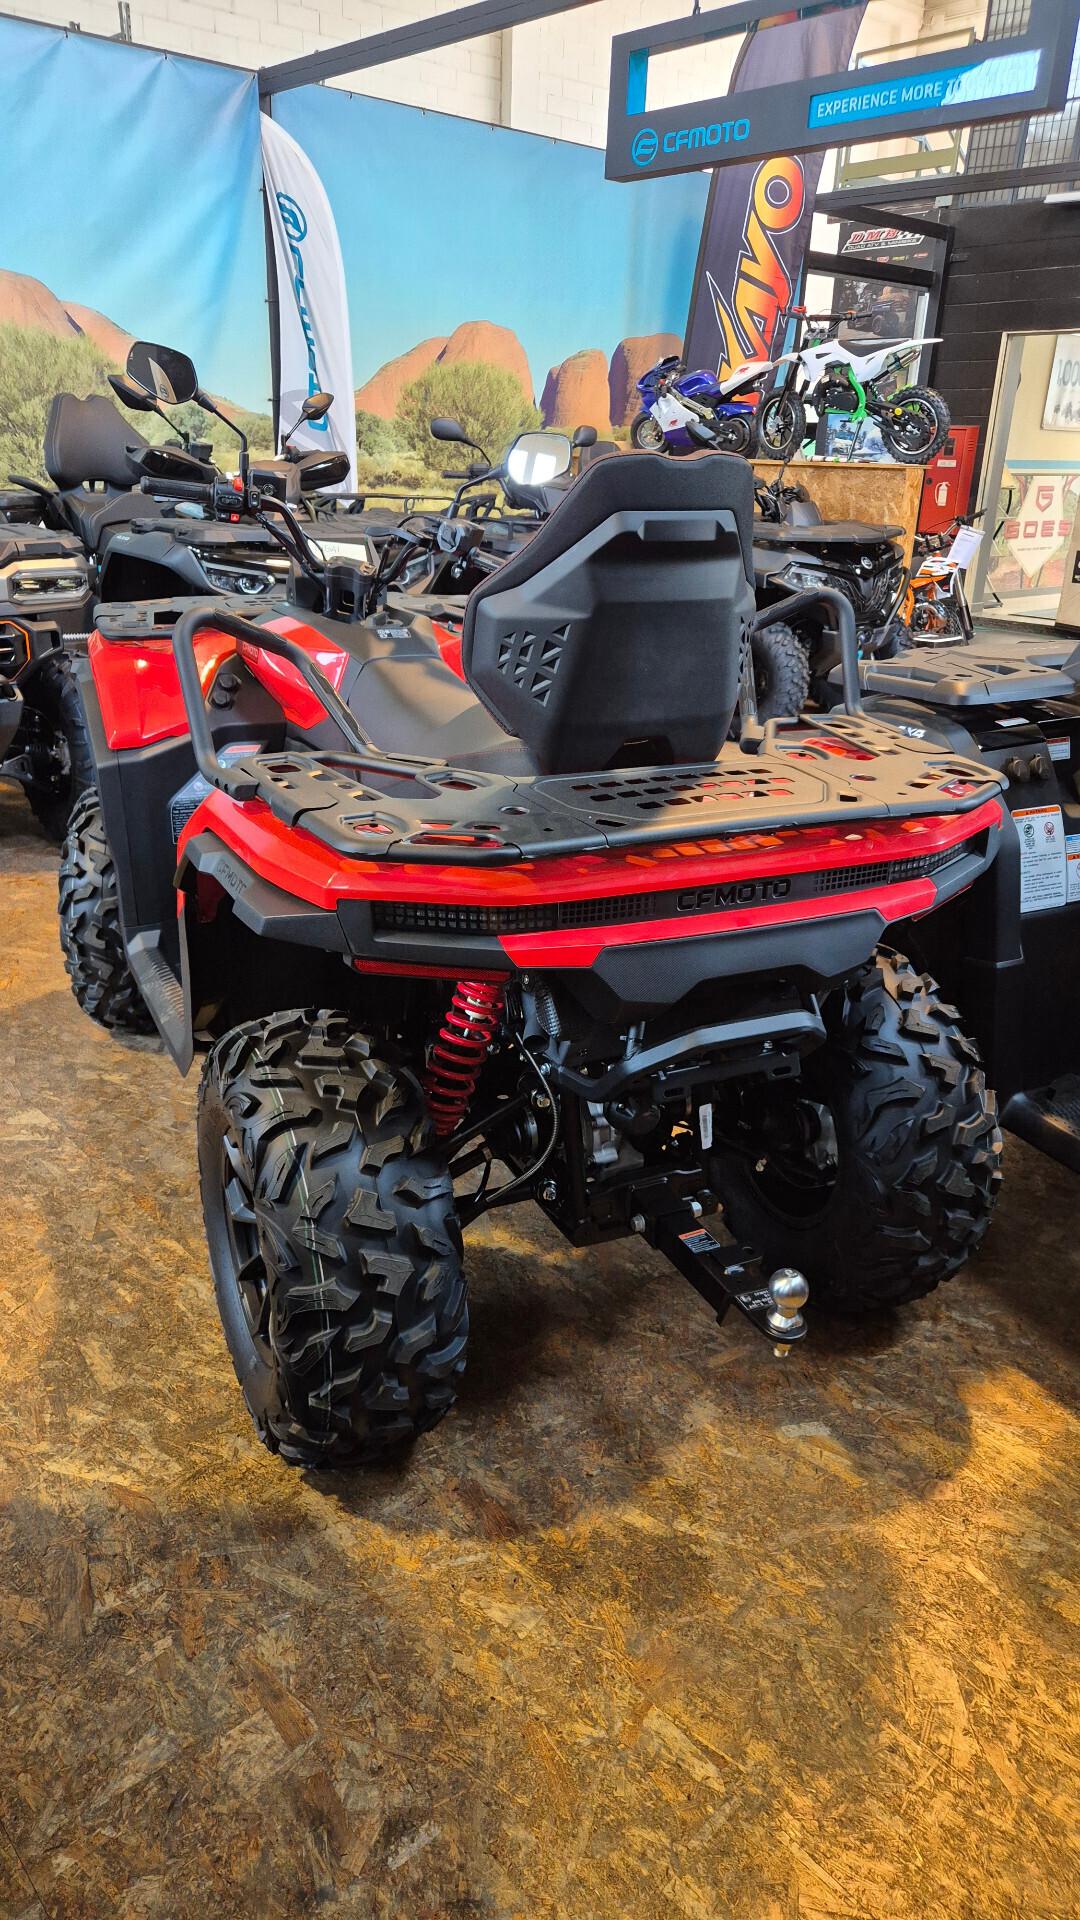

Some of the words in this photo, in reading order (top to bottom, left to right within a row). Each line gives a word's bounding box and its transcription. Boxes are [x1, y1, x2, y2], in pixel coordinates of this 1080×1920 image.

[817, 88, 897, 118] EXPERIENCE
[901, 81, 942, 103] MORE
[663, 118, 750, 153] CFMOTO
[1004, 519, 1072, 539] GOES
[676, 878, 791, 912] CFMOTO
